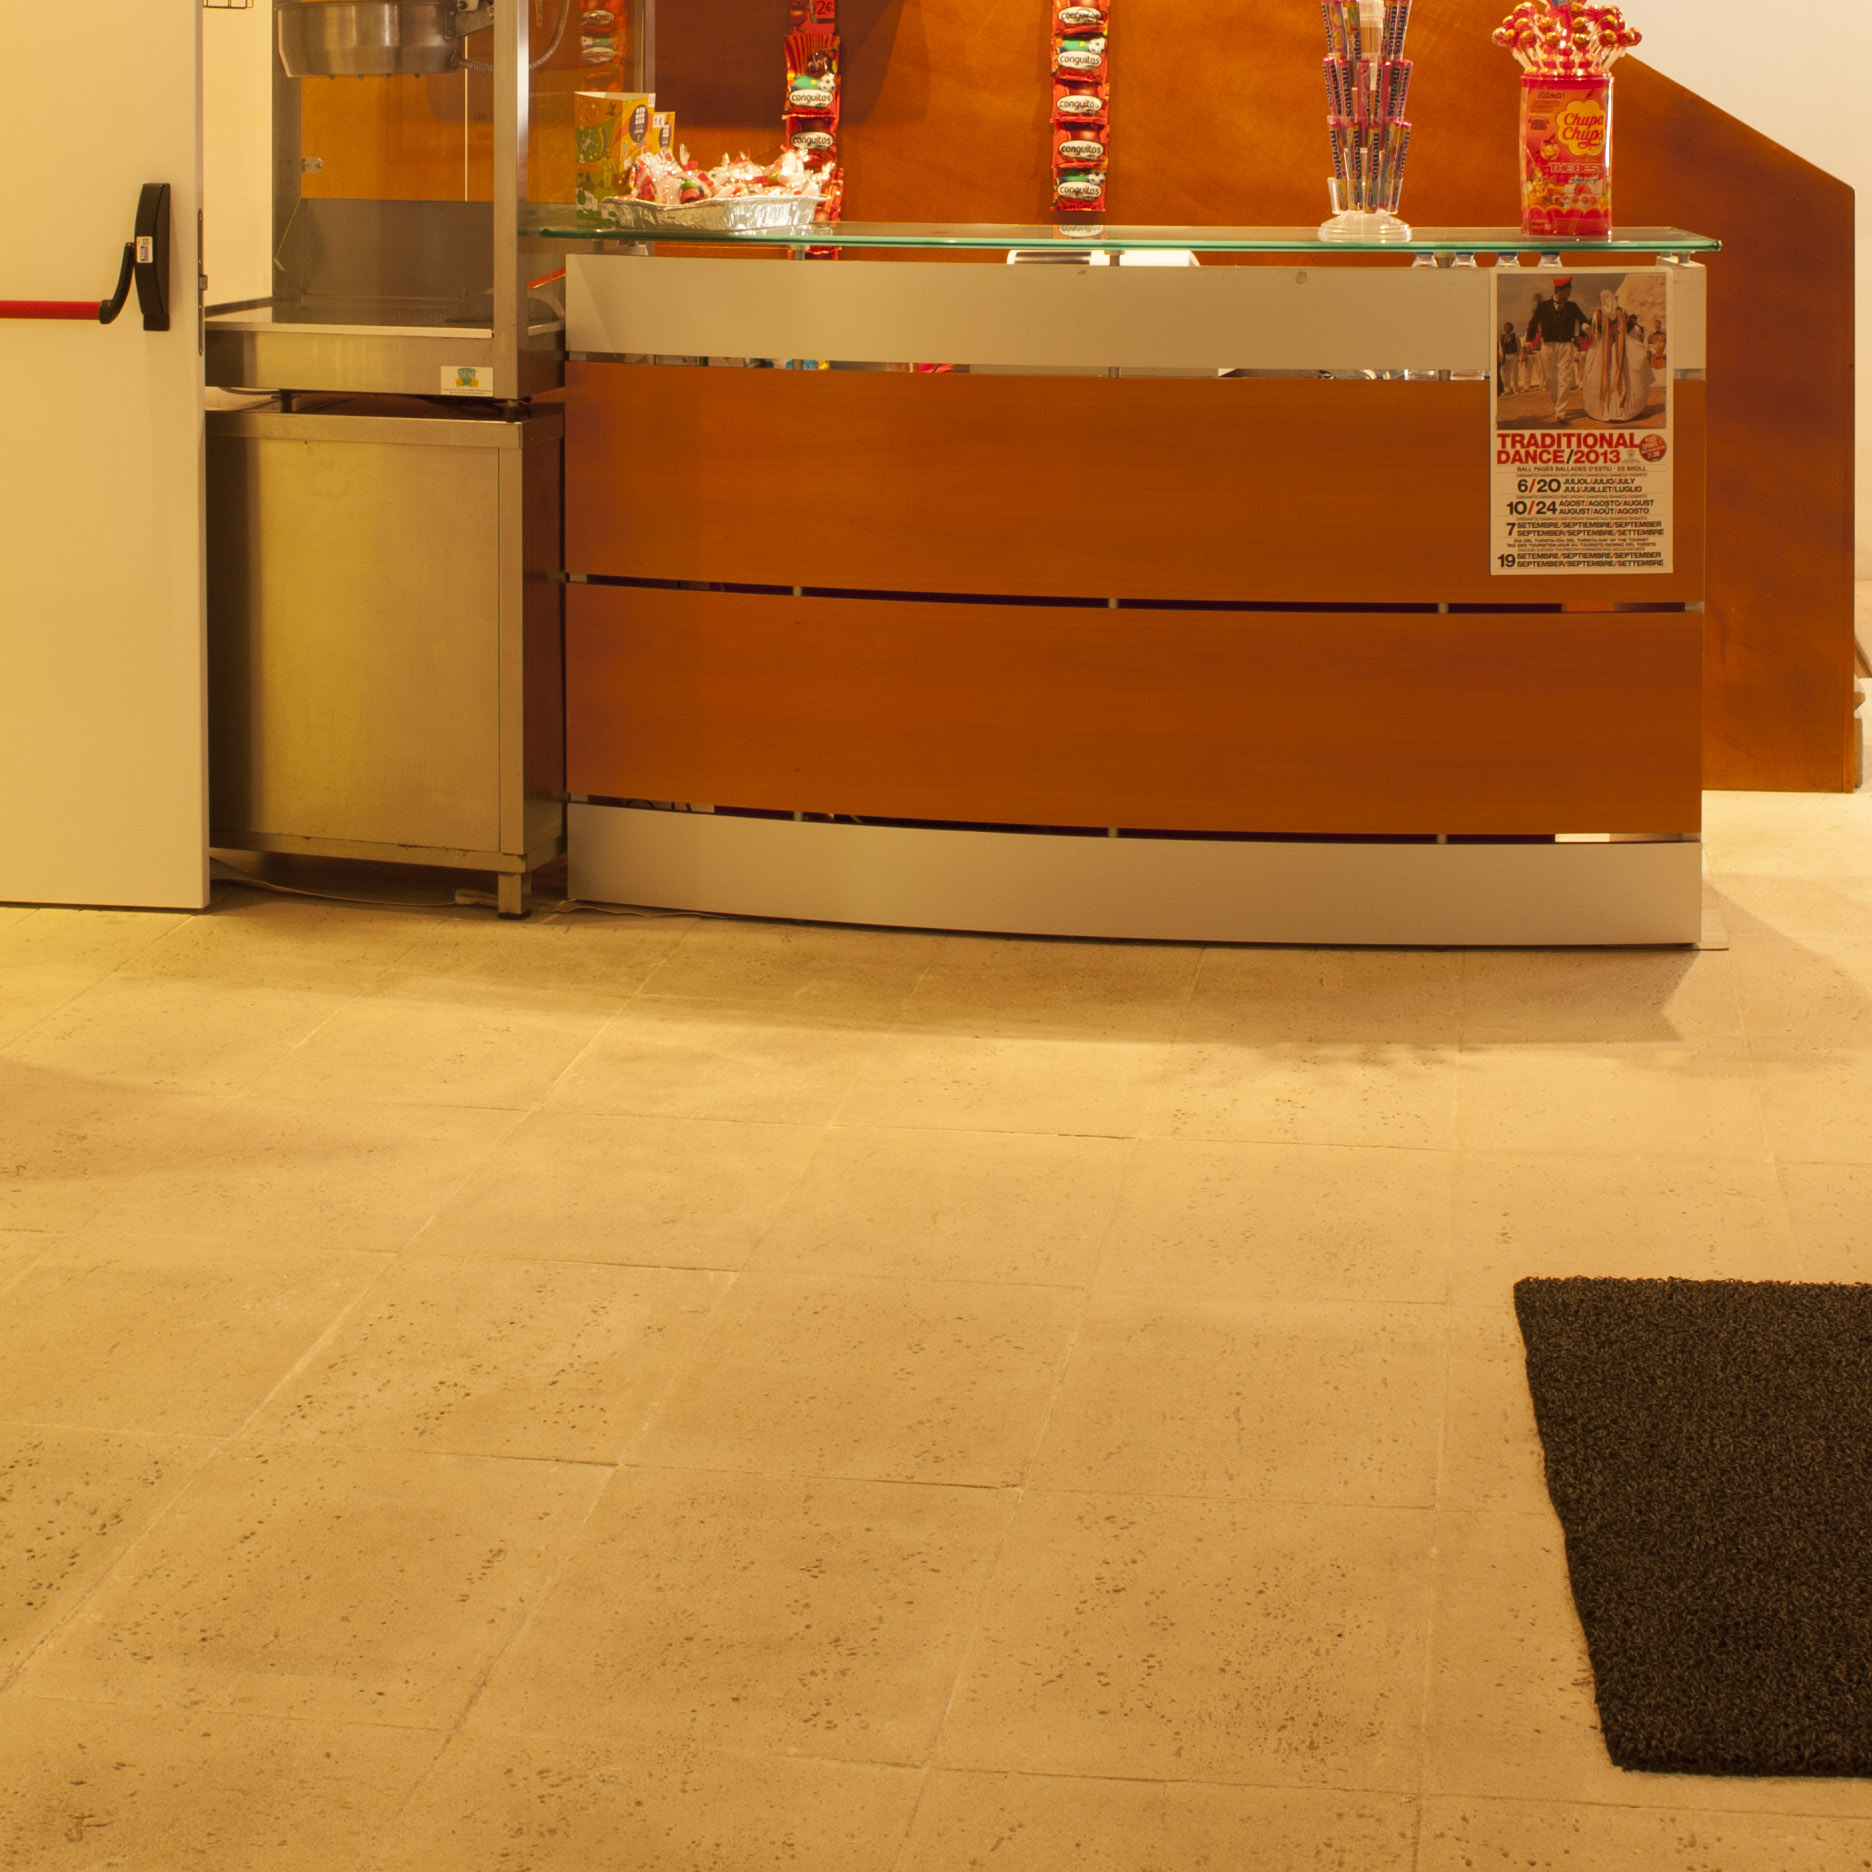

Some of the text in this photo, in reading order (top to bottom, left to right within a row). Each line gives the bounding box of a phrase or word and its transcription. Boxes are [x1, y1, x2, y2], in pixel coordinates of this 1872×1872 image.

[1394, 6, 1407, 54] mentos
[1059, 54, 1100, 66] conguitos
[791, 93, 832, 105] conguitos
[1341, 67, 1353, 116] mentos
[1388, 67, 1400, 116] mentos
[1564, 113, 1603, 129] Chupa
[792, 135, 831, 146] conguitos
[1562, 127, 1604, 149] Chups
[1060, 144, 1101, 155] conguitos
[1330, 130, 1342, 179] mentos
[1059, 185, 1100, 196] conguitos
[1497, 432, 1640, 449] TRADITIONAL
[1497, 449, 1621, 464] DANCE/2013
[1517, 478, 1561, 493] 6/20
[1506, 500, 1557, 515] 10/24
[1506, 523, 1516, 536] 7
[1497, 554, 1516, 567] 19
